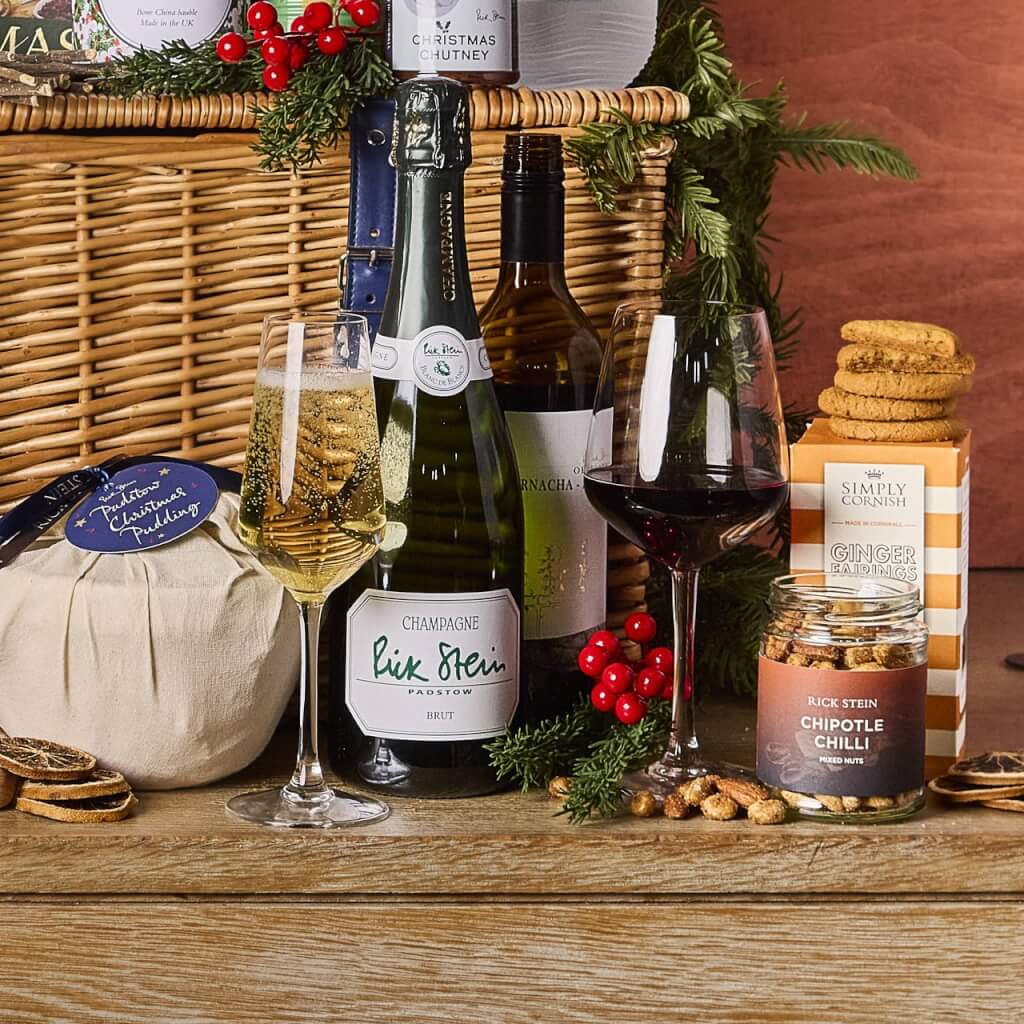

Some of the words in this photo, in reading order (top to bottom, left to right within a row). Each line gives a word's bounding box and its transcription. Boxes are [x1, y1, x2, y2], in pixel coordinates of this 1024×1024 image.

[412, 34, 496, 46] CHRISTMAS
[419, 49, 489, 61] CHUTNEY
[440, 191, 456, 302] CHAMPAGNE
[521, 478, 573, 492] RNACHA
[841, 481, 907, 495] SIMPLY
[89, 480, 160, 522] Padstow
[841, 495, 906, 508] CORNISH
[110, 487, 187, 532] Christmas
[120, 502, 200, 544] Pudding
[830, 542, 917, 565] GINGER
[402, 615, 480, 632] CHAMPAGNE
[408, 688, 473, 696] PADSTOW
[808, 696, 839, 708] RICK
[841, 698, 878, 709] STEIN
[426, 711, 455, 720] BRUT
[800, 715, 885, 733] CHIPOTLE
[814, 735, 869, 751] CHILLI
[819, 756, 843, 764] MIXED
[844, 757, 865, 765] NUTS
